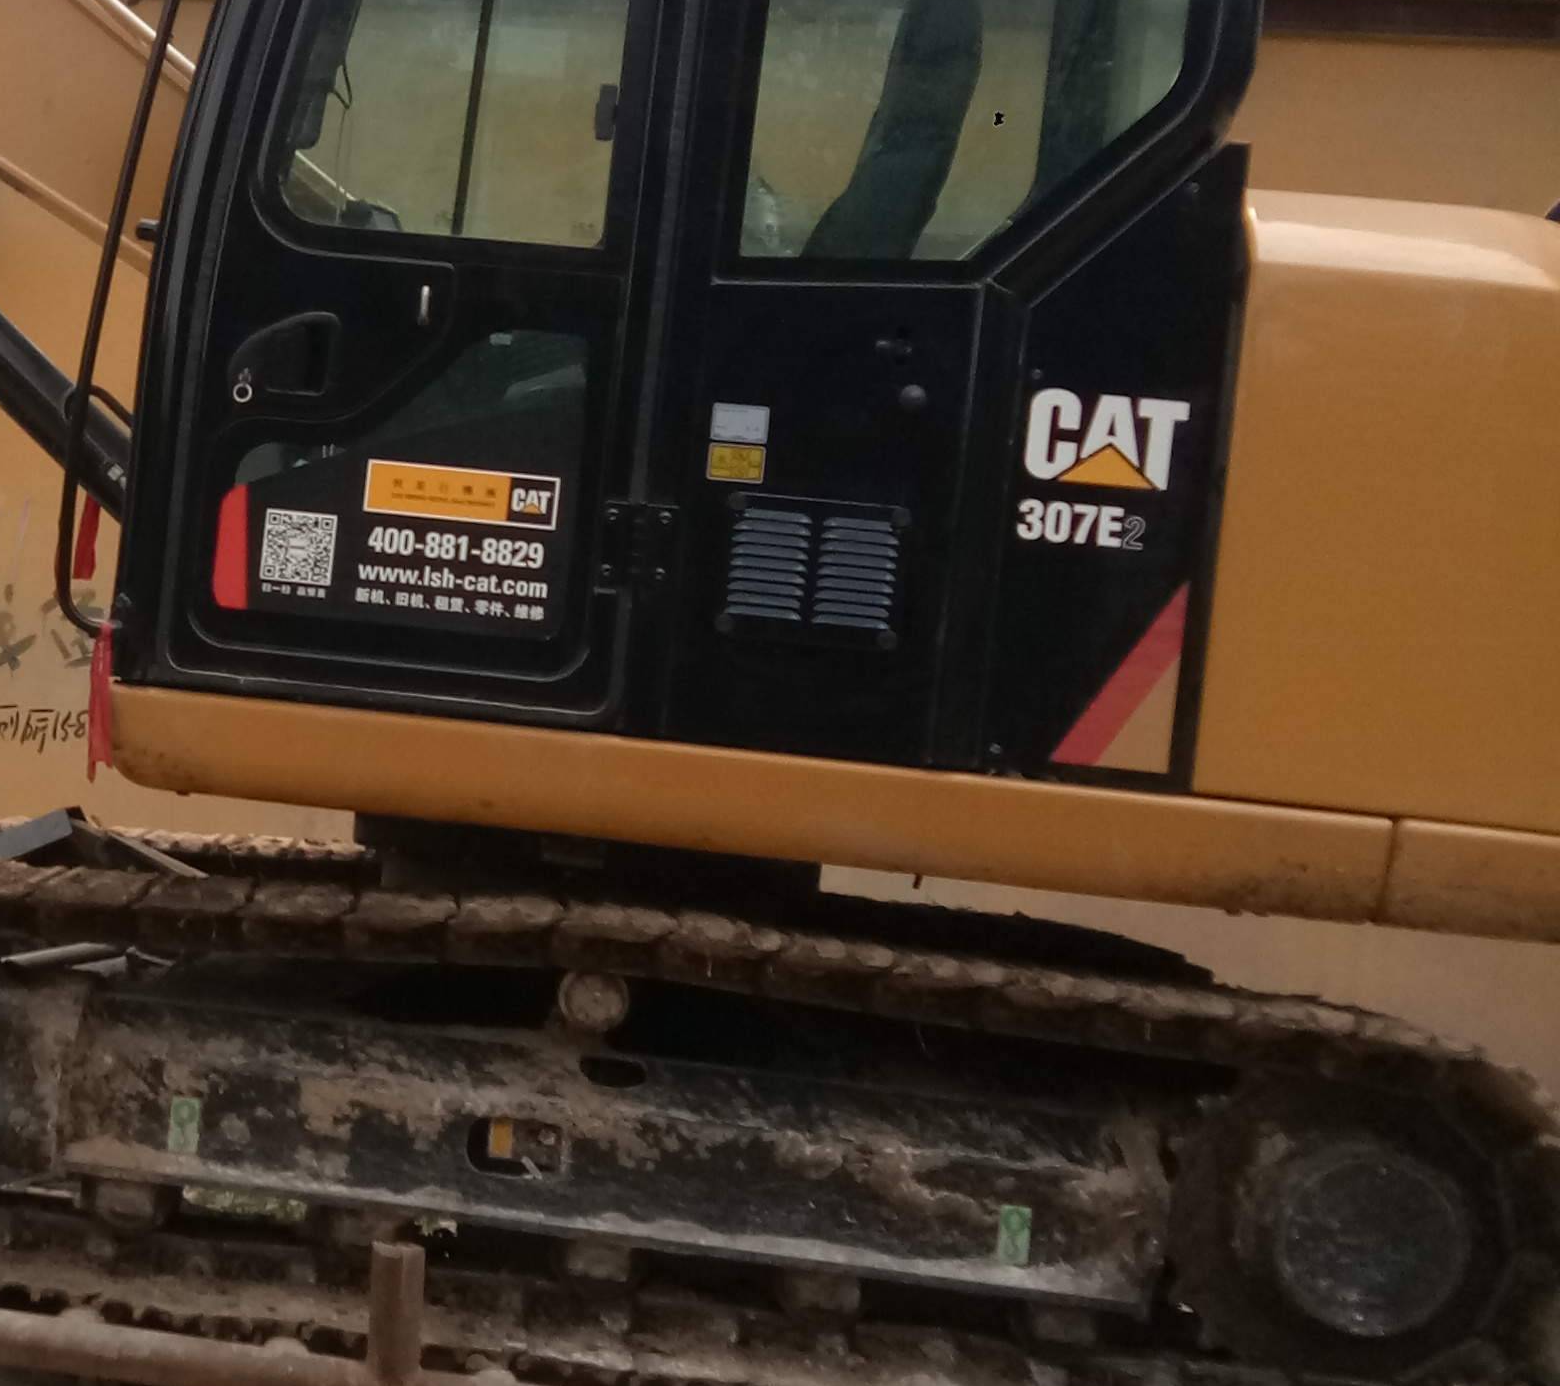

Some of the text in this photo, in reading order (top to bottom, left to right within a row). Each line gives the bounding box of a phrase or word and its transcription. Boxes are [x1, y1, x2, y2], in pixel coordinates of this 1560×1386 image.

[1024, 387, 1190, 491] CAT
[511, 487, 552, 515] CAT
[1016, 498, 1146, 550] 307E2
[367, 526, 545, 569] 400-881-8829
[358, 562, 548, 599] www.lsh-cat.com
